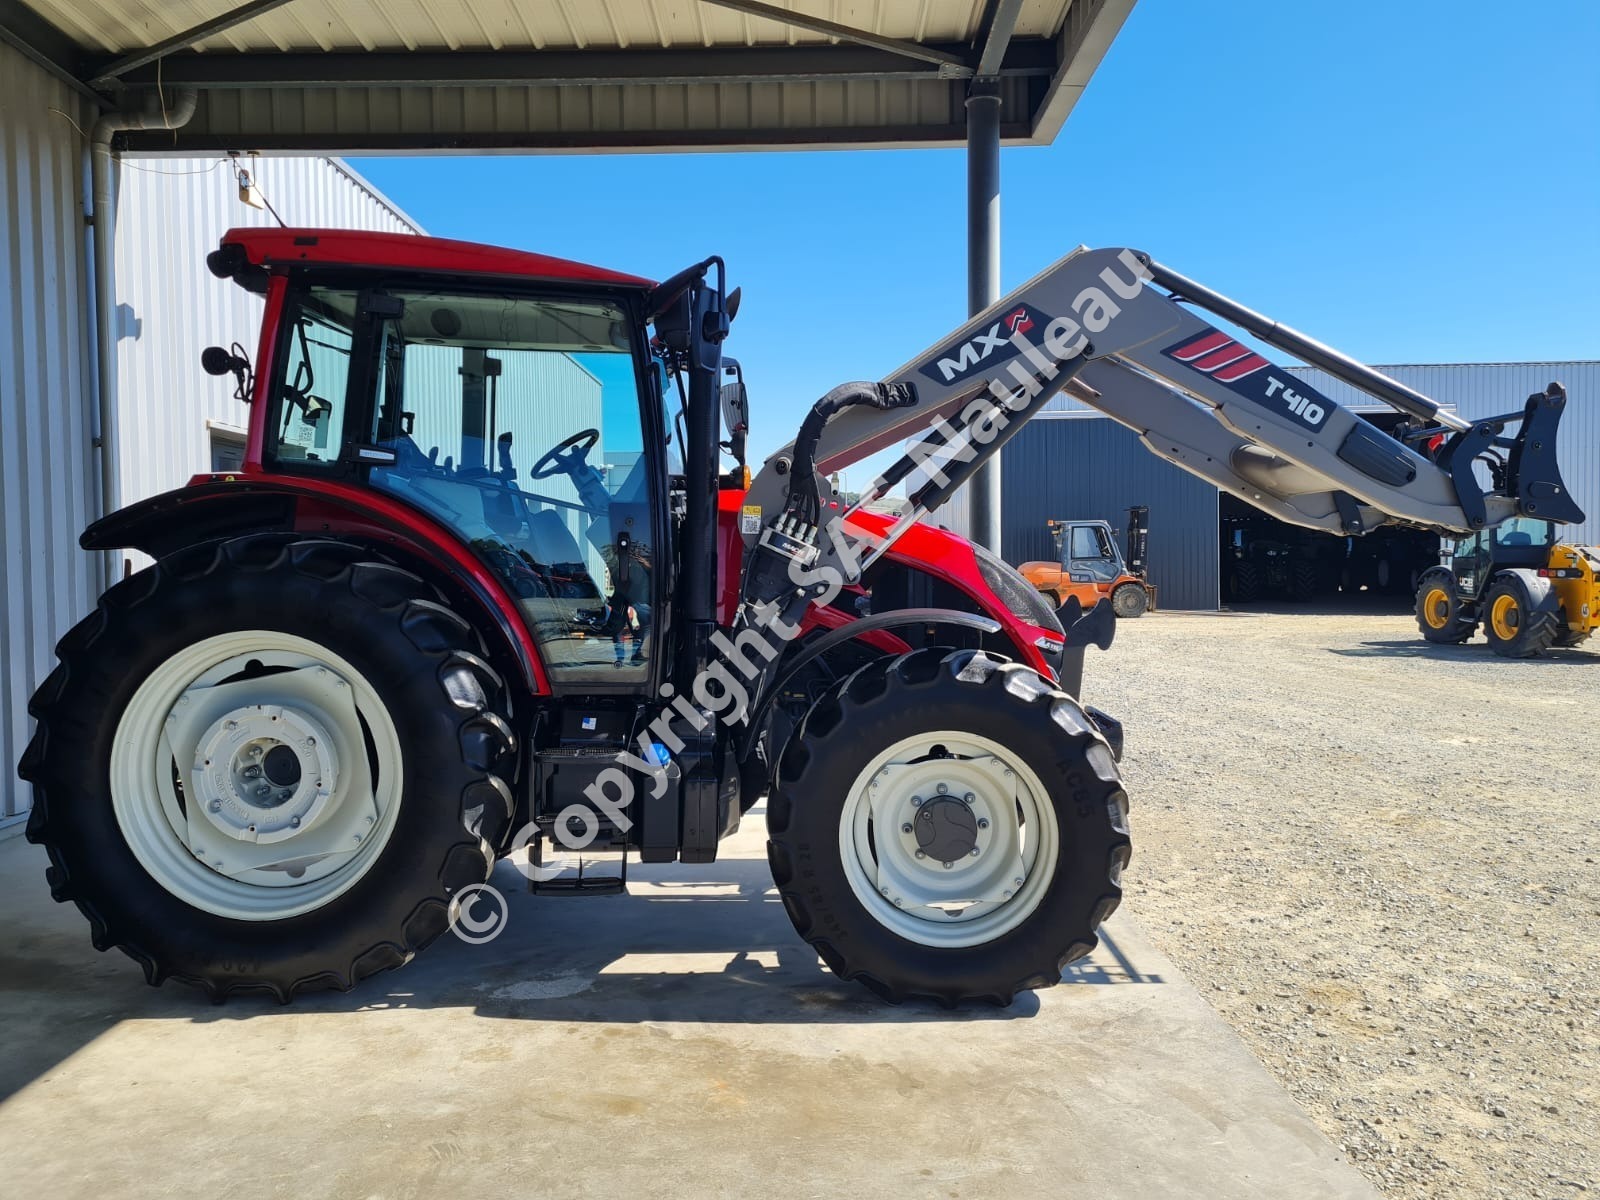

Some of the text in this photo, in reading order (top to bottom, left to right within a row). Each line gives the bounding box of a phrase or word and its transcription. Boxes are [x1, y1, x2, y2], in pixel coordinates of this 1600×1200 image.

[936, 322, 1010, 381] MX
[1264, 375, 1325, 425] T410
[1459, 576, 1474, 588] JCB
